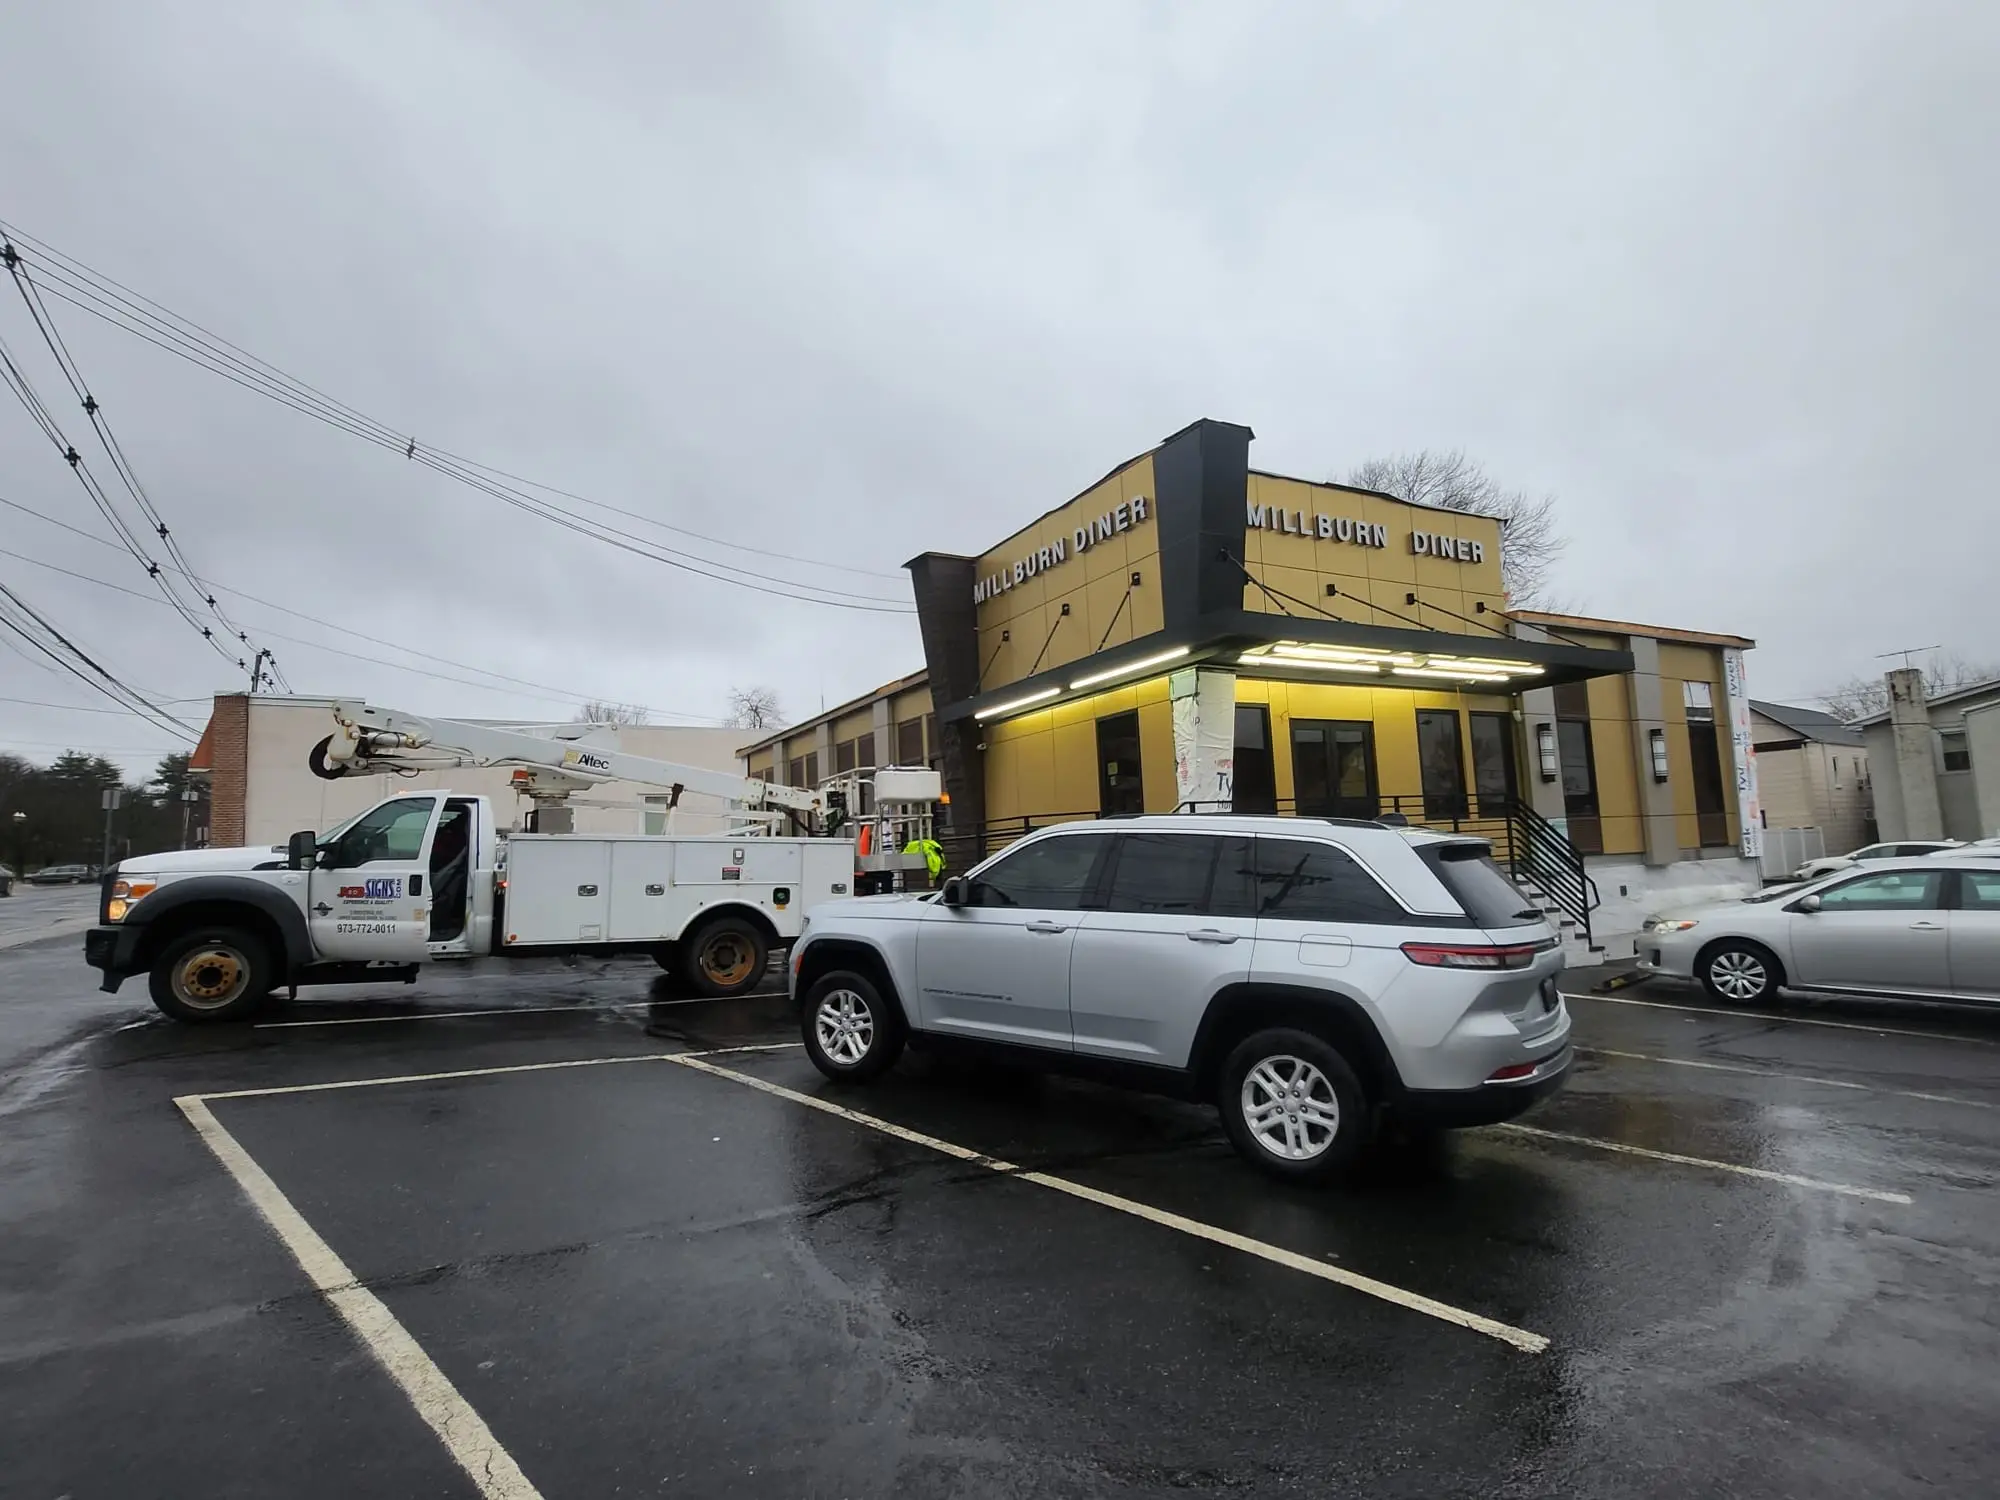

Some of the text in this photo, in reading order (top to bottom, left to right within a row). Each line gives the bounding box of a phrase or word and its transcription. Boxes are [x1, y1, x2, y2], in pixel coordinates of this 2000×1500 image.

[1247, 501, 1484, 563] MILLBURN DINER
[973, 495, 1147, 604] MILLBURN DINER
[577, 753, 610, 770] Altec
[365, 878, 395, 898] SIGNS
[337, 923, 396, 934] 973-772-0011
